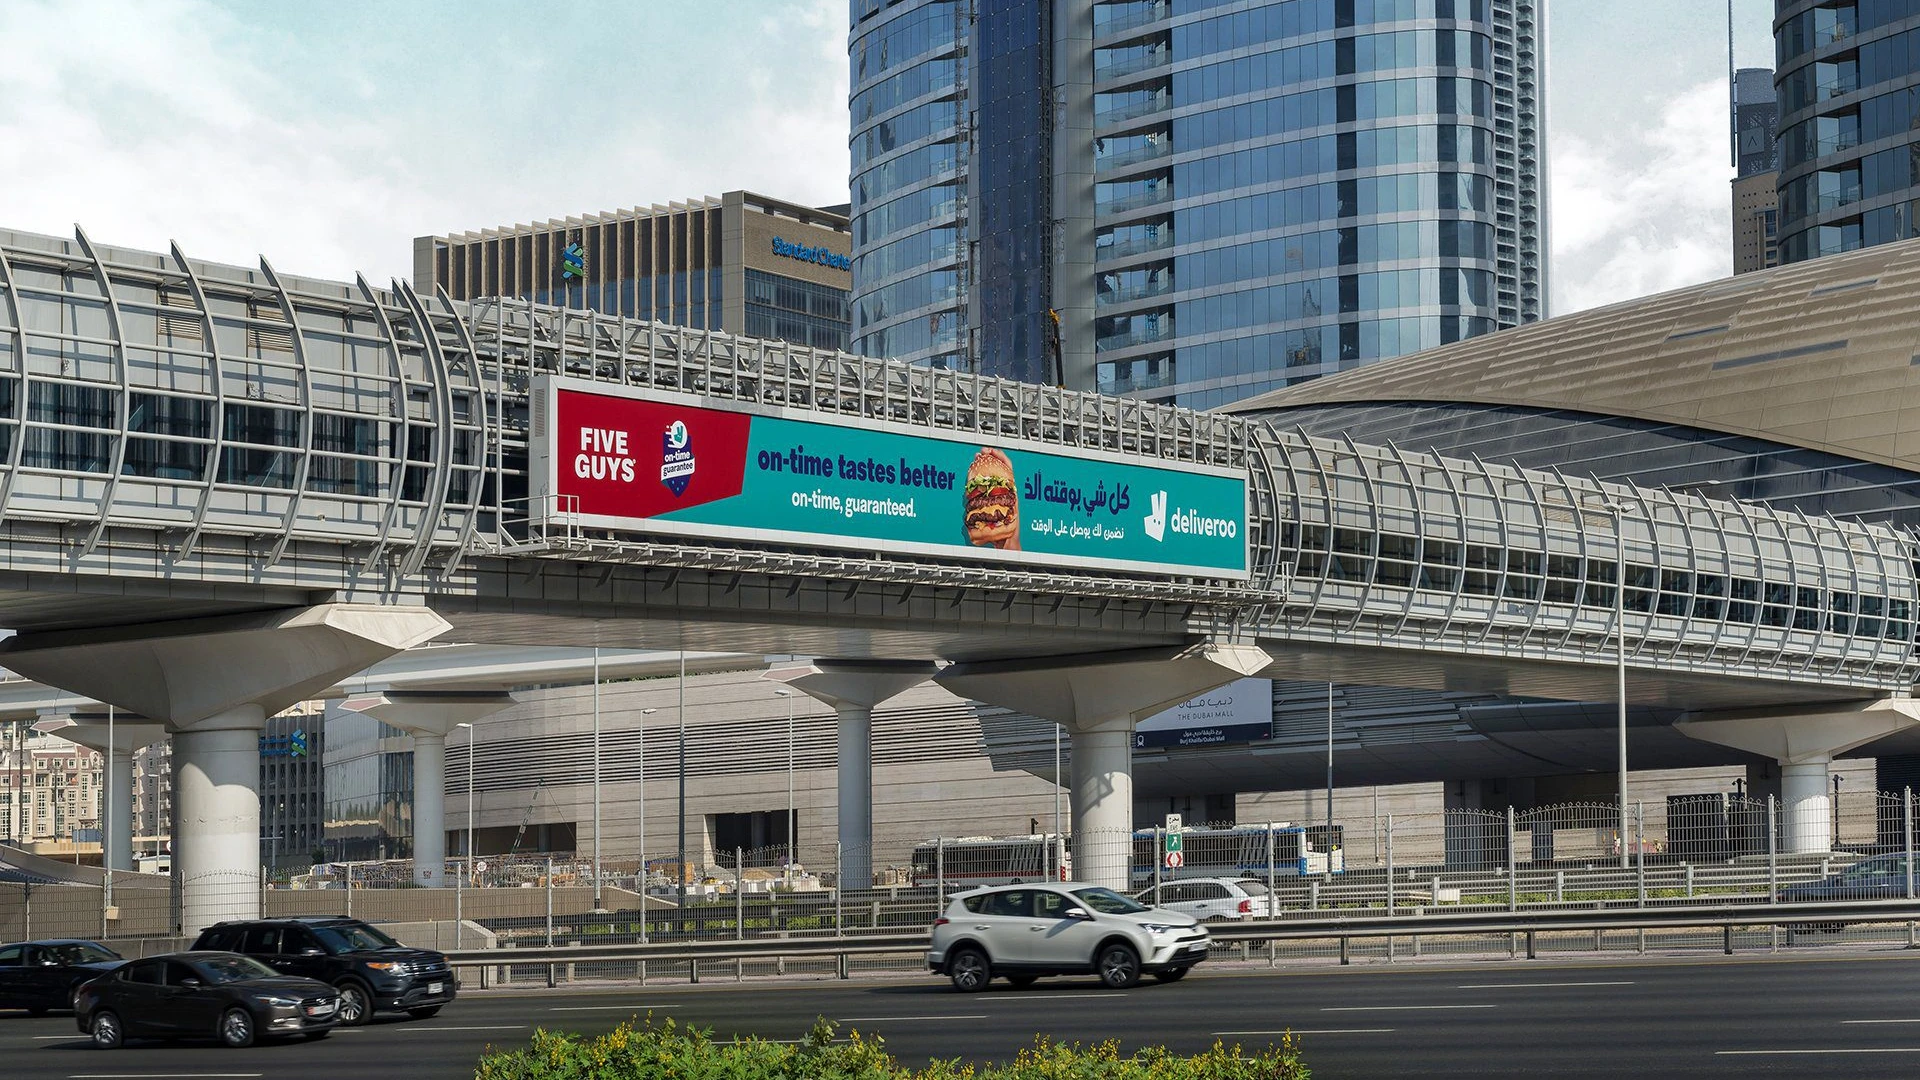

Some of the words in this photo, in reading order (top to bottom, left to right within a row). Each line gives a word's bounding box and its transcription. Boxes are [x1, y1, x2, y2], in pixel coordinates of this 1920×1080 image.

[772, 236, 818, 264] Standard
[581, 427, 628, 454] FIVE
[663, 462, 694, 477] guarantee
[664, 450, 691, 462] on-time
[758, 444, 833, 478] on-time
[838, 454, 896, 484] tastes
[900, 458, 955, 490] better
[791, 488, 843, 514] on-time,
[845, 497, 917, 518] guaranteed.
[1044, 480, 1081, 511] بوقته
[1109, 483, 1130, 515] كل
[1031, 519, 1053, 535] الوقت
[1171, 507, 1236, 538] deliveroo
[1193, 711, 1214, 719] DUBAI
